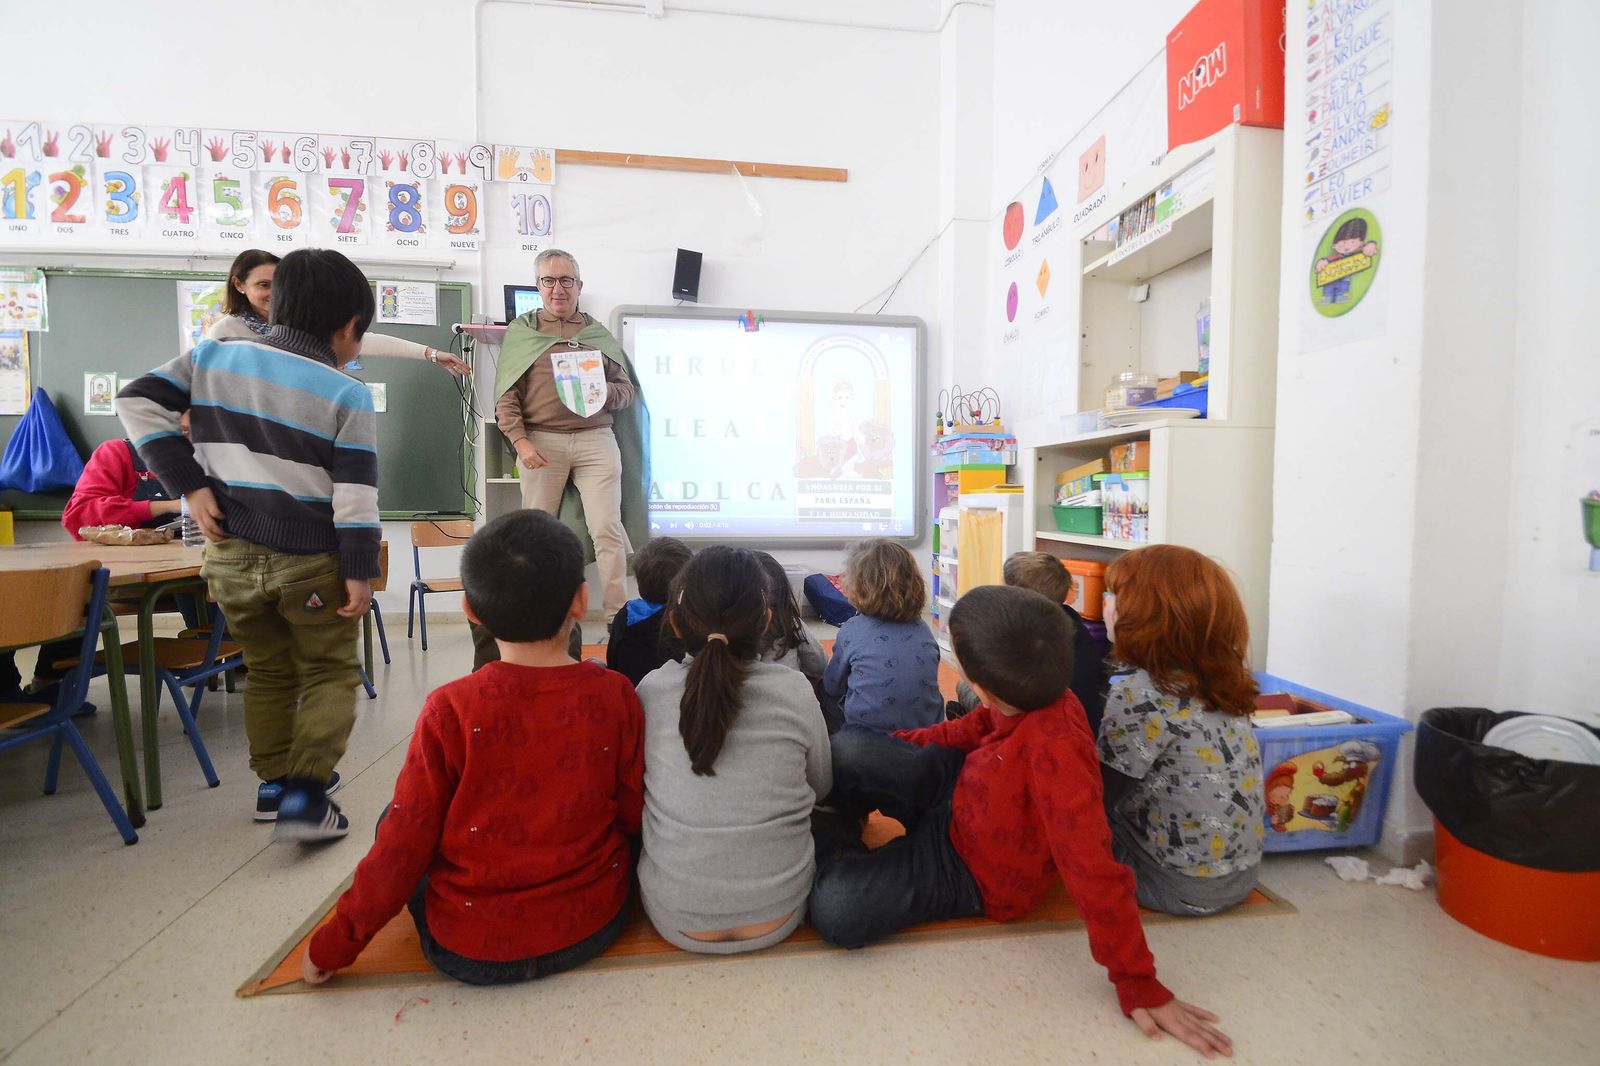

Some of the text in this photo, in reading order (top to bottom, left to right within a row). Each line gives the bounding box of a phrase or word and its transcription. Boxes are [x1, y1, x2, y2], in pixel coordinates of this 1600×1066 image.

[1323, 100, 1367, 138] SILVIO
[16, 122, 42, 162] 1
[68, 125, 94, 162] 2
[122, 127, 146, 164] 3
[175, 128, 201, 166] 4
[232, 131, 256, 169] 5
[294, 137, 318, 173] 6
[350, 141, 373, 175] 7
[411, 142, 435, 178] 8
[469, 145, 492, 181] 9
[517, 172, 528, 182] 10
[1, 168, 30, 219] 1
[49, 172, 86, 223] 2
[103, 171, 137, 223] 3
[159, 176, 194, 224] 4
[213, 179, 244, 226] 5
[1320, 172, 1345, 196] LEO
[268, 180, 302, 229] 6
[328, 178, 364, 233] 7
[389, 184, 423, 233] 8
[445, 185, 477, 234] 9
[511, 194, 551, 236] 10
[1073, 194, 1106, 223] CUADRADO
[110, 228, 129, 236] TRES
[162, 230, 195, 238] CUATRO
[219, 231, 244, 239] CINCO
[277, 234, 293, 242] SEIS
[337, 235, 358, 243] SIETE
[396, 239, 419, 247] OCHO
[450, 241, 476, 249] NUEVE
